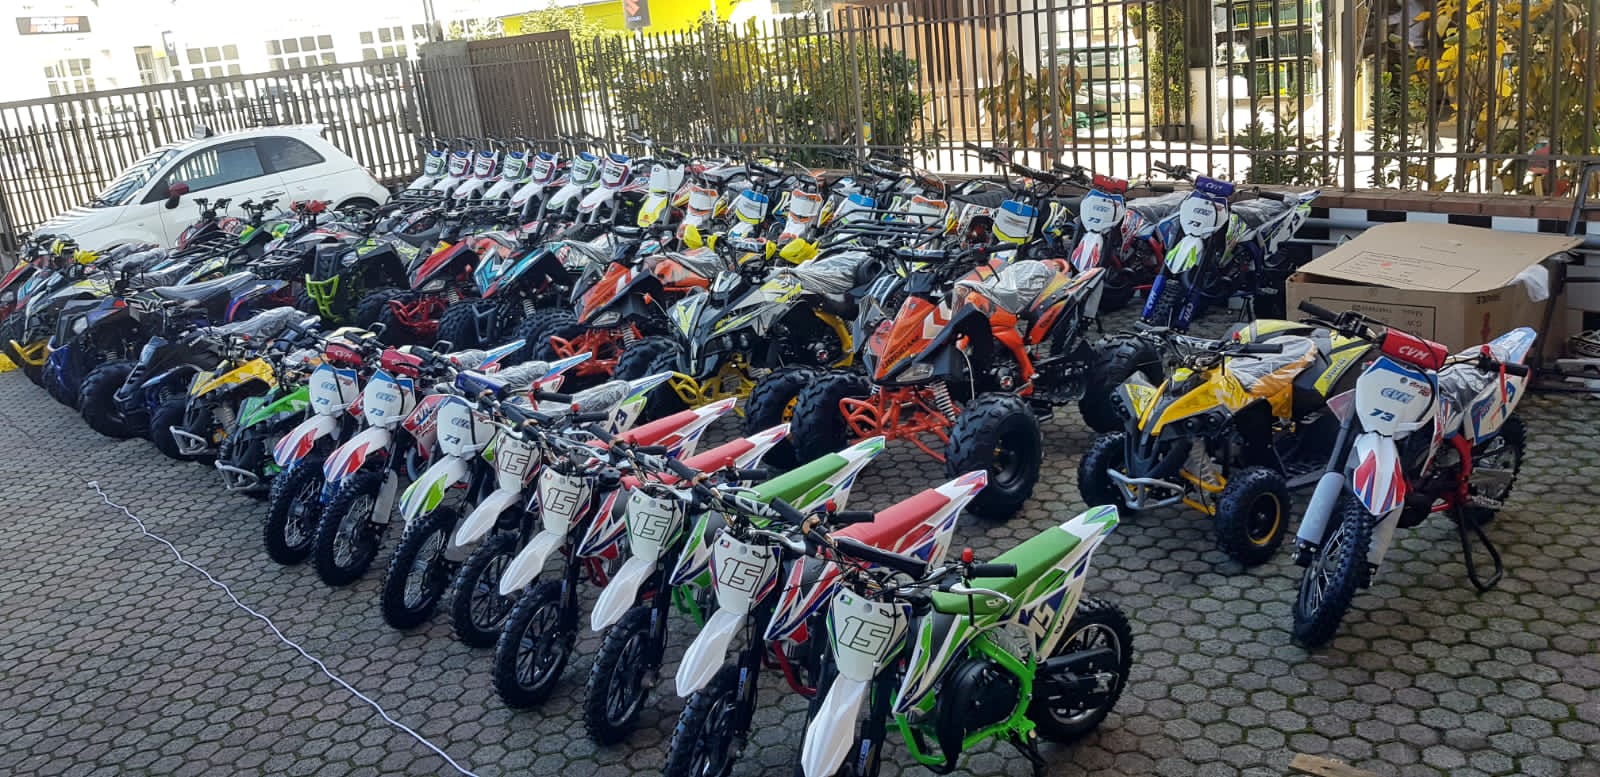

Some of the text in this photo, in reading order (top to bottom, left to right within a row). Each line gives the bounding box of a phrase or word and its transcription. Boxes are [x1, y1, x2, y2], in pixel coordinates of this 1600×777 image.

[1399, 345, 1429, 361] CVM
[1370, 408, 1395, 422] 73
[444, 434, 461, 445] 73
[500, 450, 530, 476] 15
[543, 487, 580, 517] 15
[633, 511, 674, 543] 15
[718, 557, 764, 593] 15
[838, 615, 892, 656] 15
